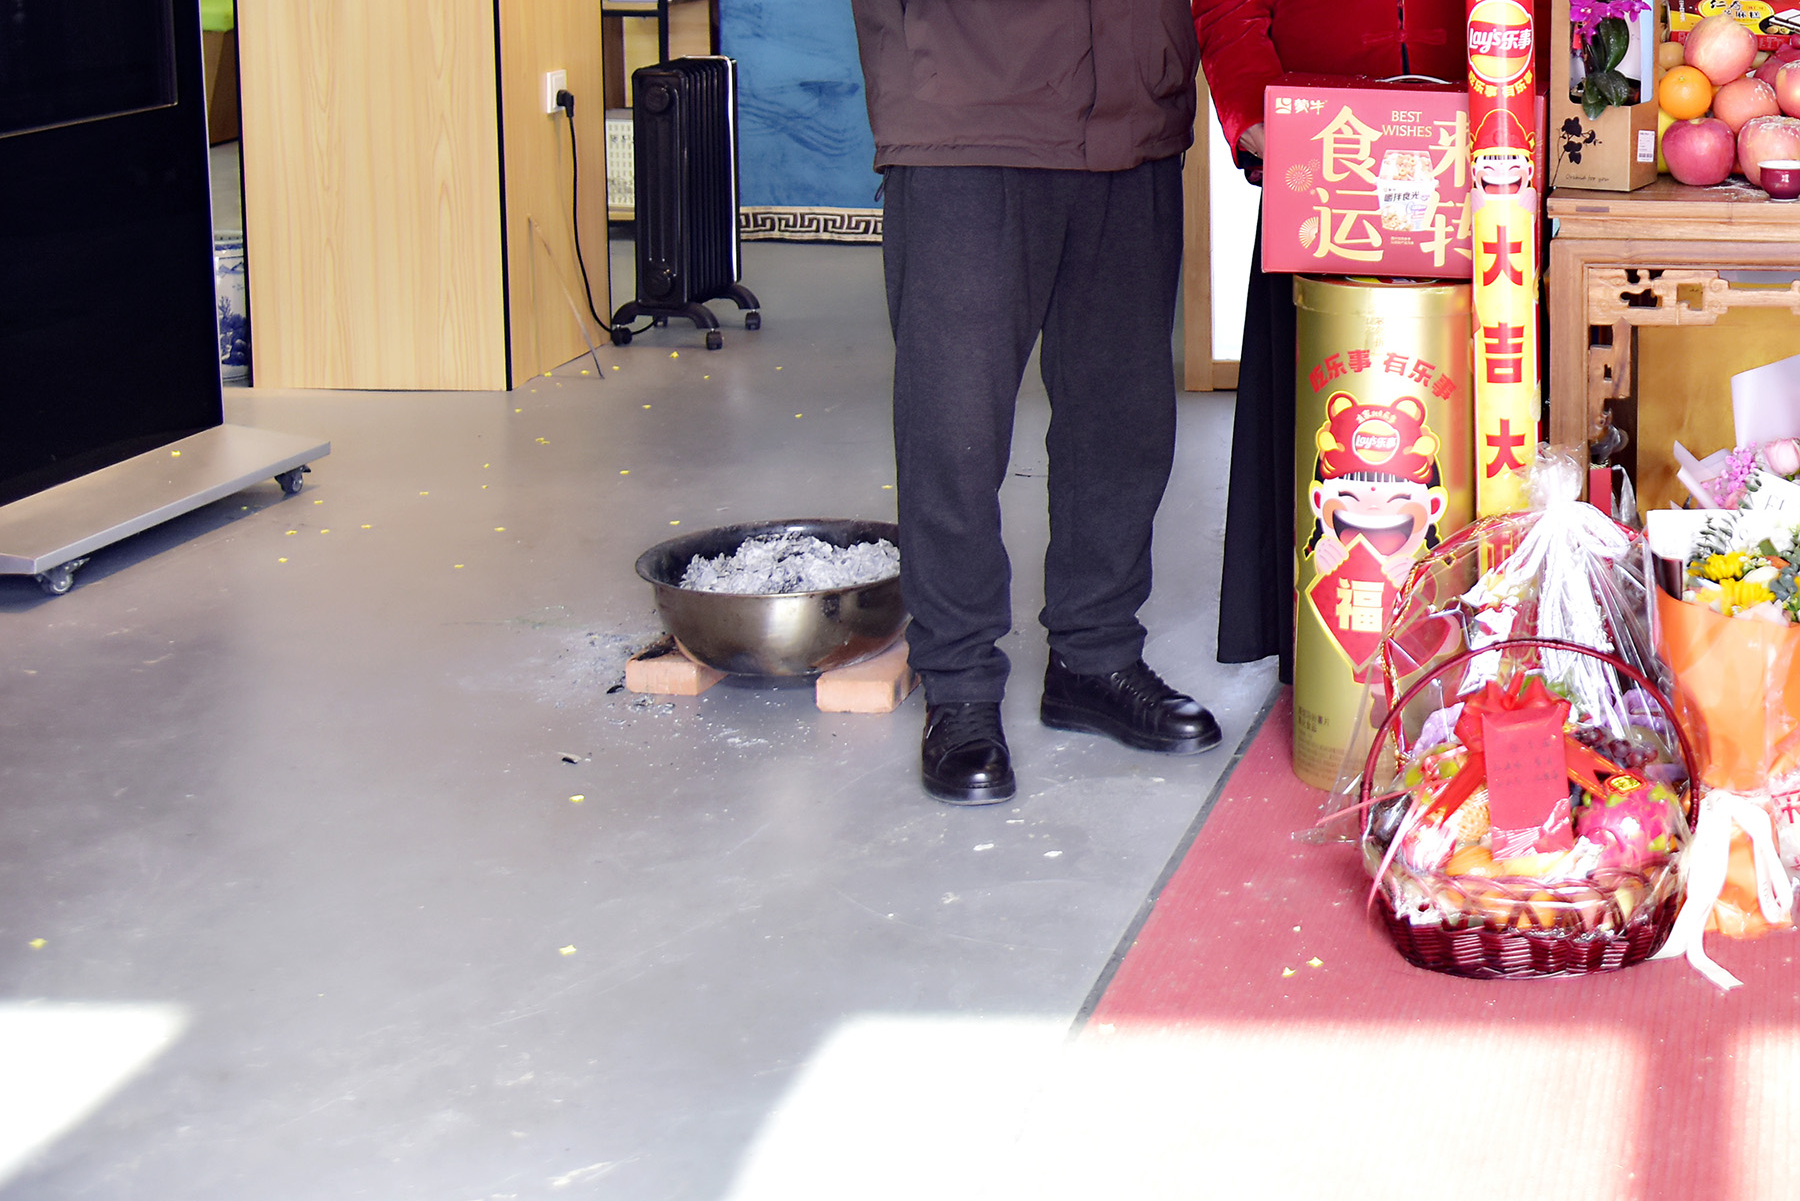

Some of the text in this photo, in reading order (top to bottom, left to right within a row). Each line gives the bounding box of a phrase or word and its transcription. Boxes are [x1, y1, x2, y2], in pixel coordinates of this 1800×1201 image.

[1294, 99, 1325, 114] 蒙牛
[1391, 111, 1422, 122] BEST
[1382, 125, 1433, 137] WISHES
[1308, 350, 1457, 401] 吃乐事 有乐事
[1335, 578, 1386, 634] 福
